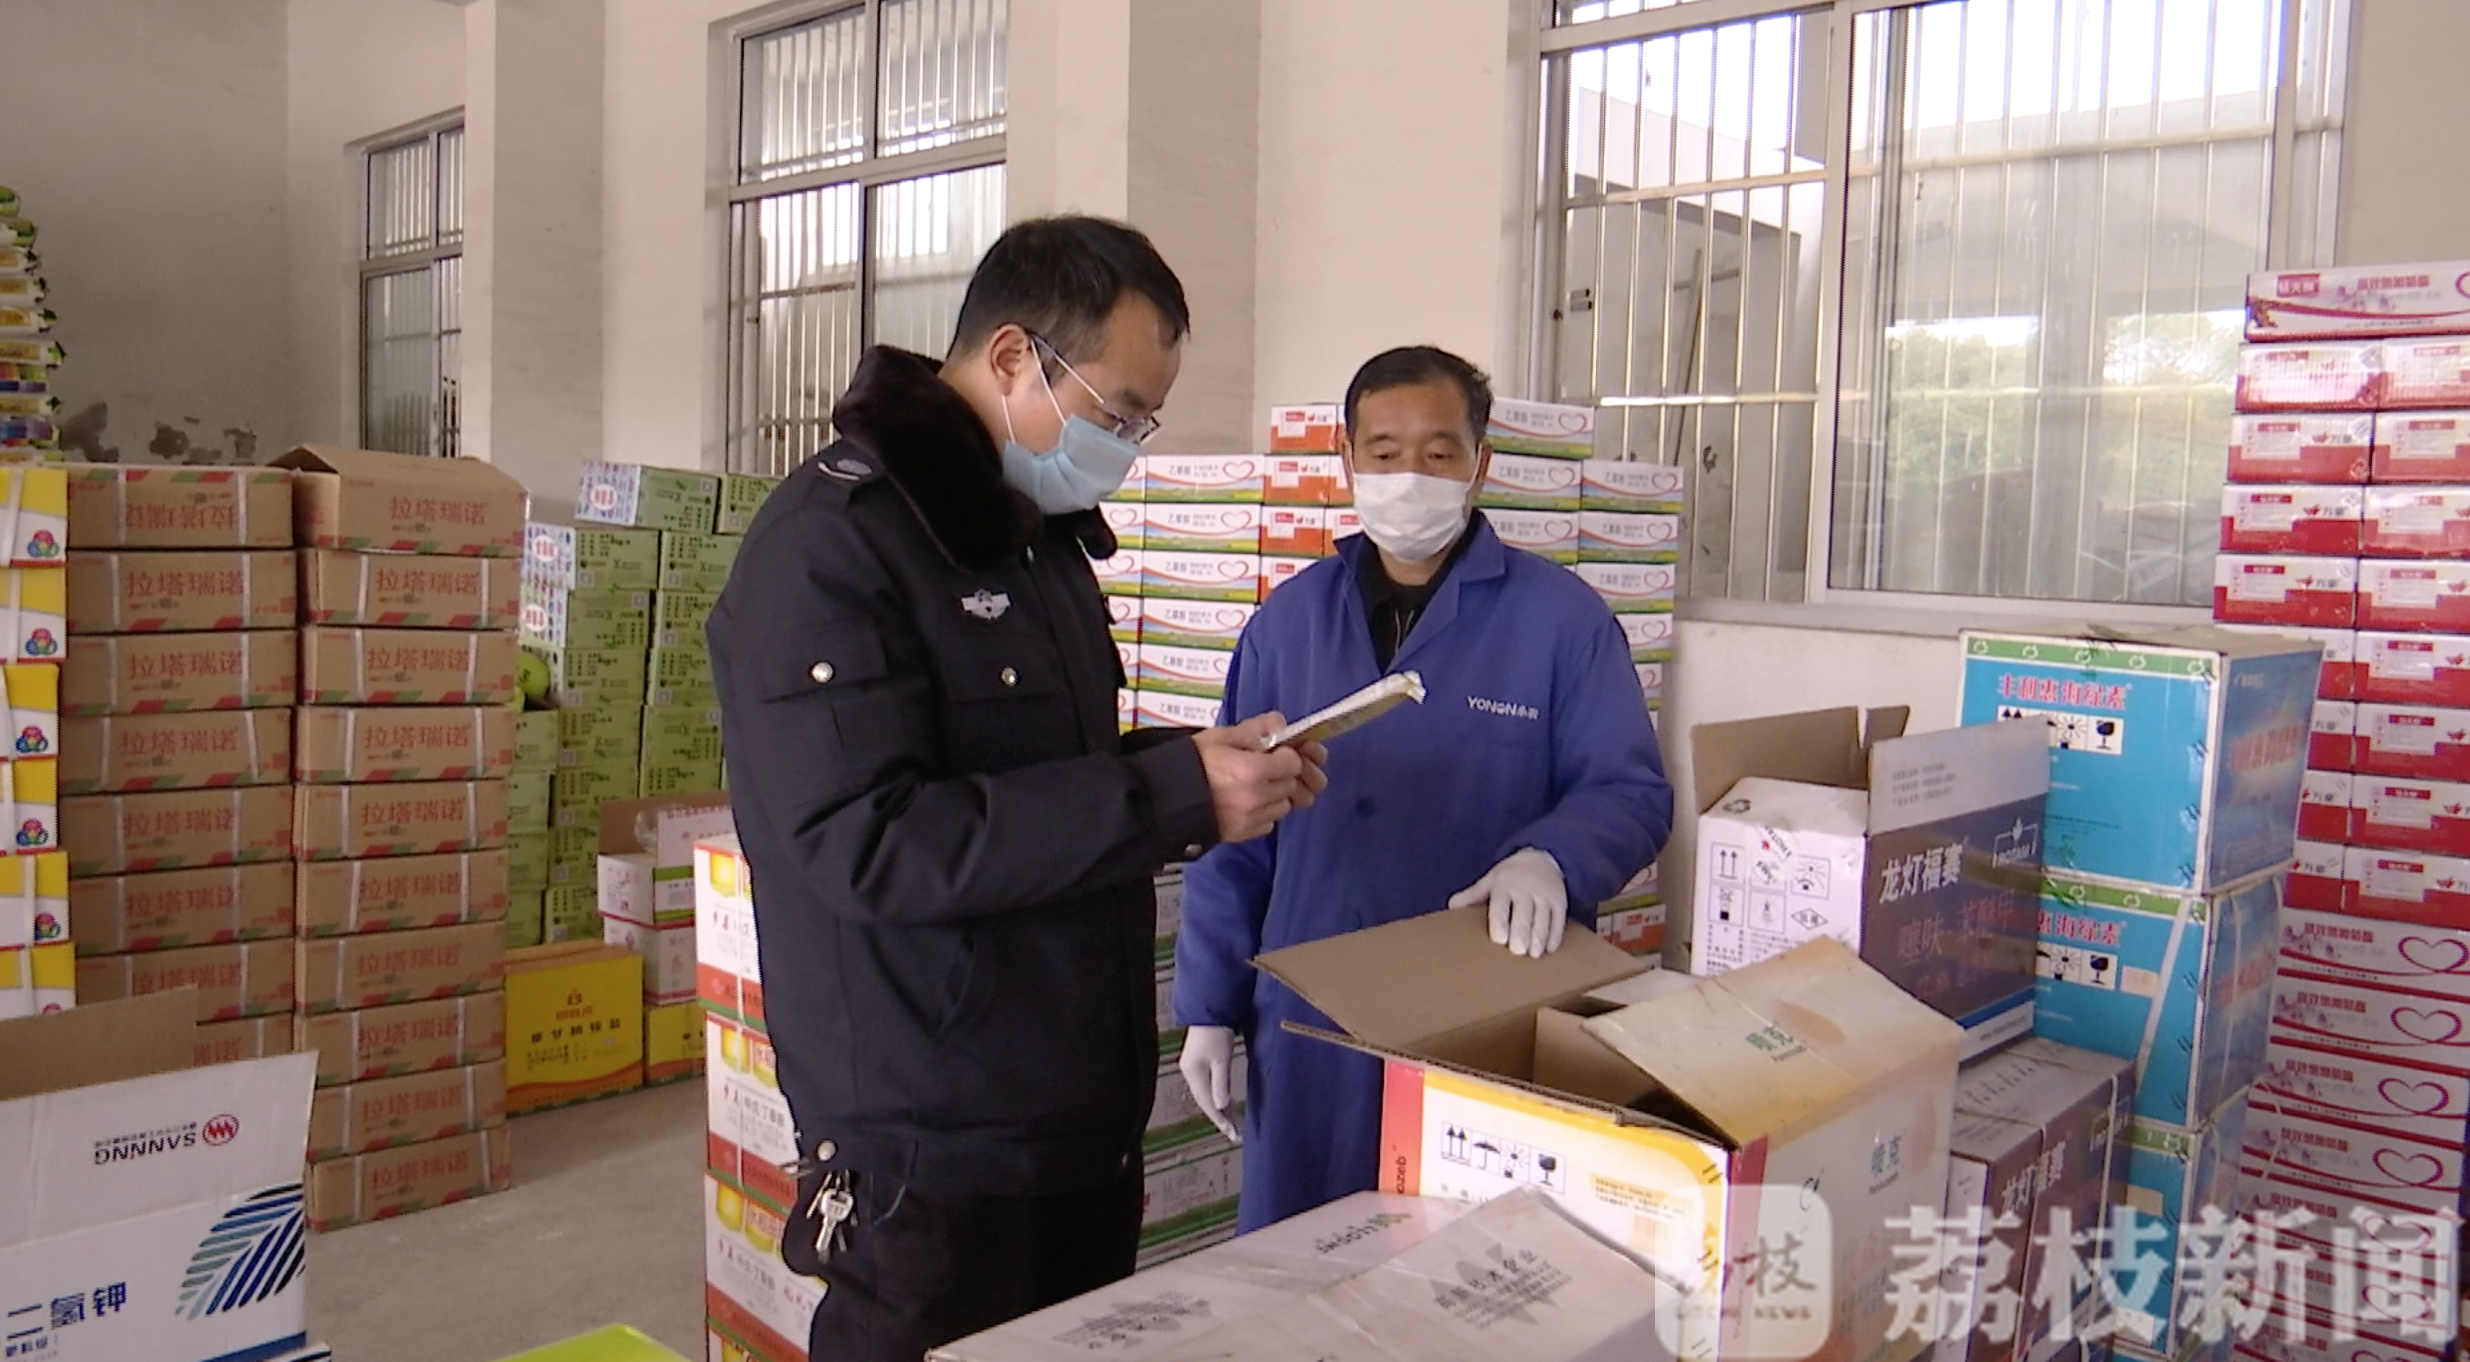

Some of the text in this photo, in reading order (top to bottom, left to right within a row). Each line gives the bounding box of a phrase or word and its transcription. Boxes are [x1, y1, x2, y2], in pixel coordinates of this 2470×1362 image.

[389, 496, 487, 526] 拉塔瑞诺
[126, 570, 243, 597] 拉塔瑞诺
[376, 568, 480, 595] 拉塔瑞诺
[129, 650, 242, 677] 拉塔瑞诺
[367, 647, 470, 671] 拉塔瑞诺
[120, 726, 238, 755] 拉塔瑞诺
[363, 724, 471, 749] 拉塔瑞诺
[124, 807, 234, 837] 拉塔瑞诺
[361, 797, 466, 826] 拉塔瑞诺
[359, 871, 461, 901] 拉塔瑞诺
[1879, 842, 1964, 904] 龙灯福赛
[125, 883, 235, 917] 拉塔瑞诺
[357, 942, 462, 975] 拉塔瑞诺
[359, 1013, 459, 1047] 拉塔瑞诺
[362, 1085, 464, 1123] 拉塔瑞诺
[371, 1149, 471, 1188] 拉塔瑞诺
[7, 1281, 127, 1340] 二氢钾
